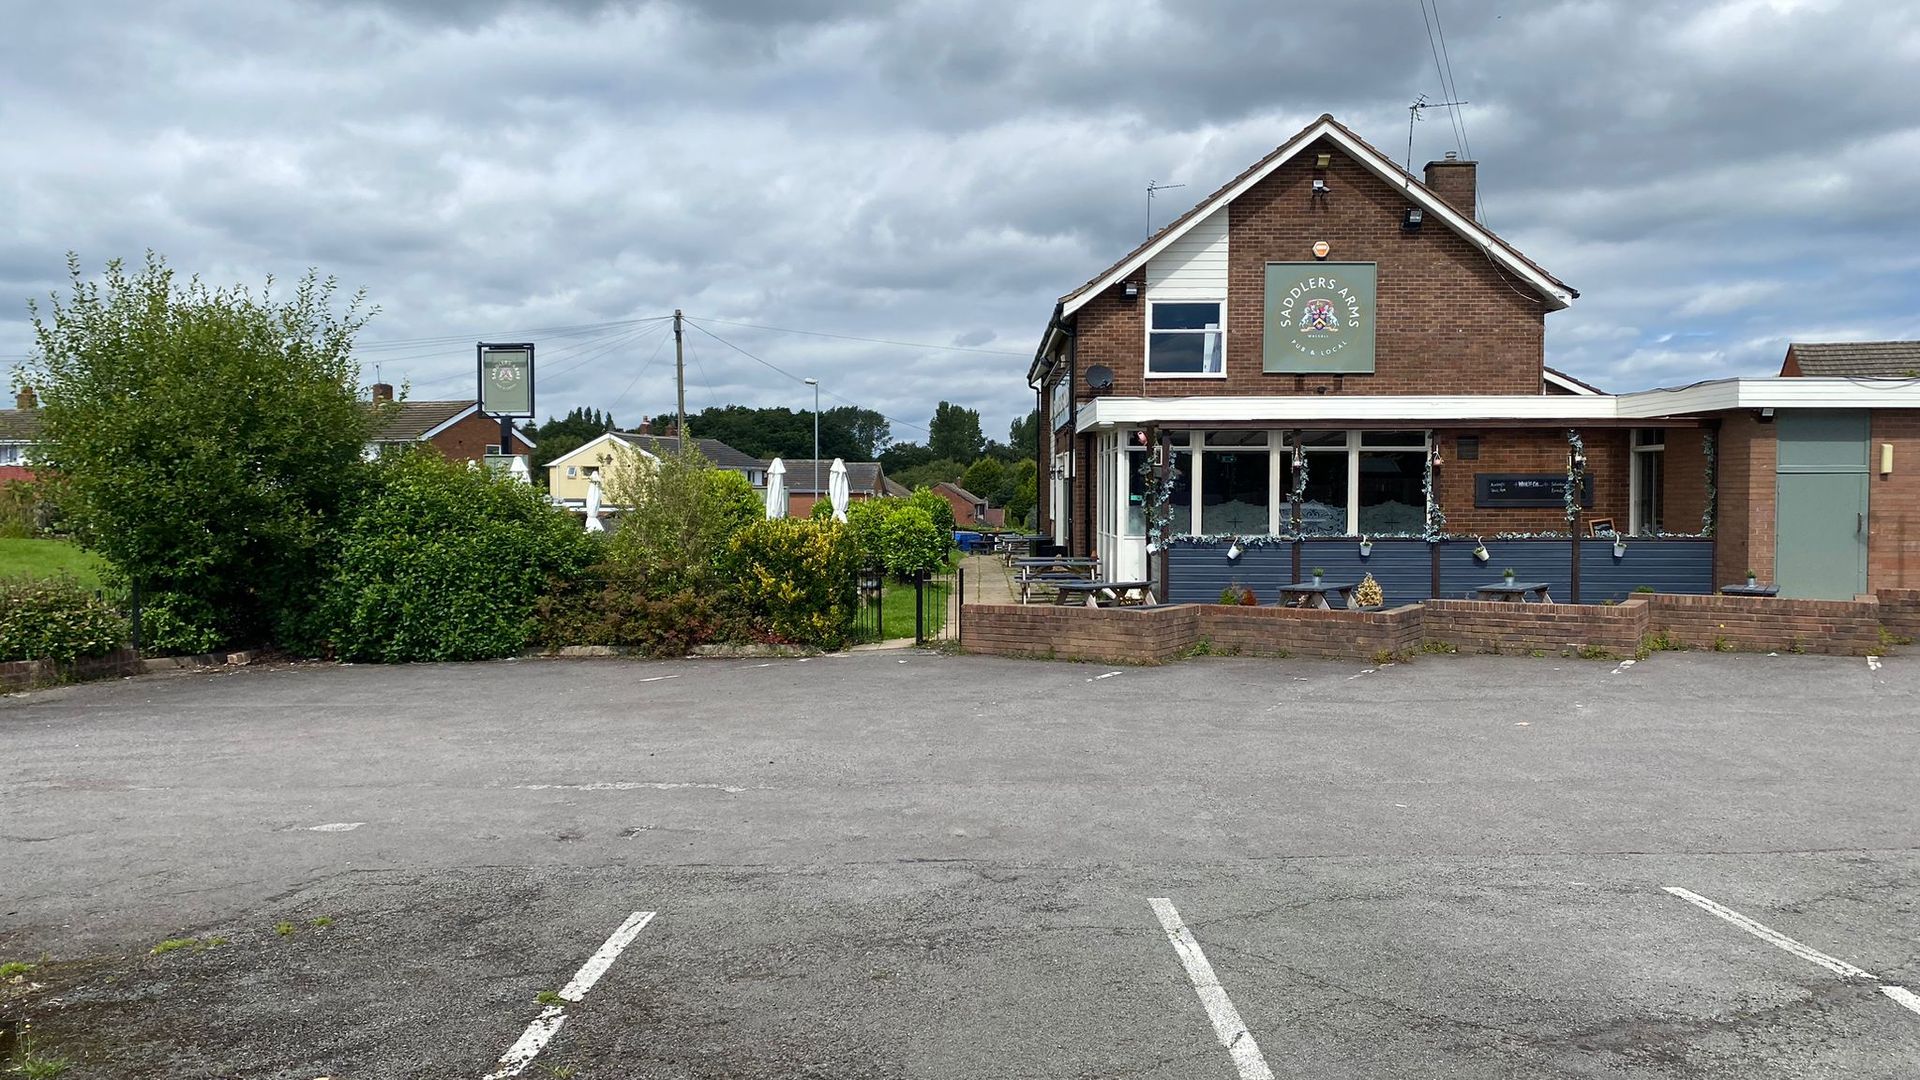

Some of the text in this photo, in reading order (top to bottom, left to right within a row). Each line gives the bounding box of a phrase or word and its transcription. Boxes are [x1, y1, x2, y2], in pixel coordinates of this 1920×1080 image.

[1280, 277, 1360, 328] SADDLERS ARMS
[1290, 339, 1306, 352] PUB
[1320, 340, 1347, 356] LOCAL
